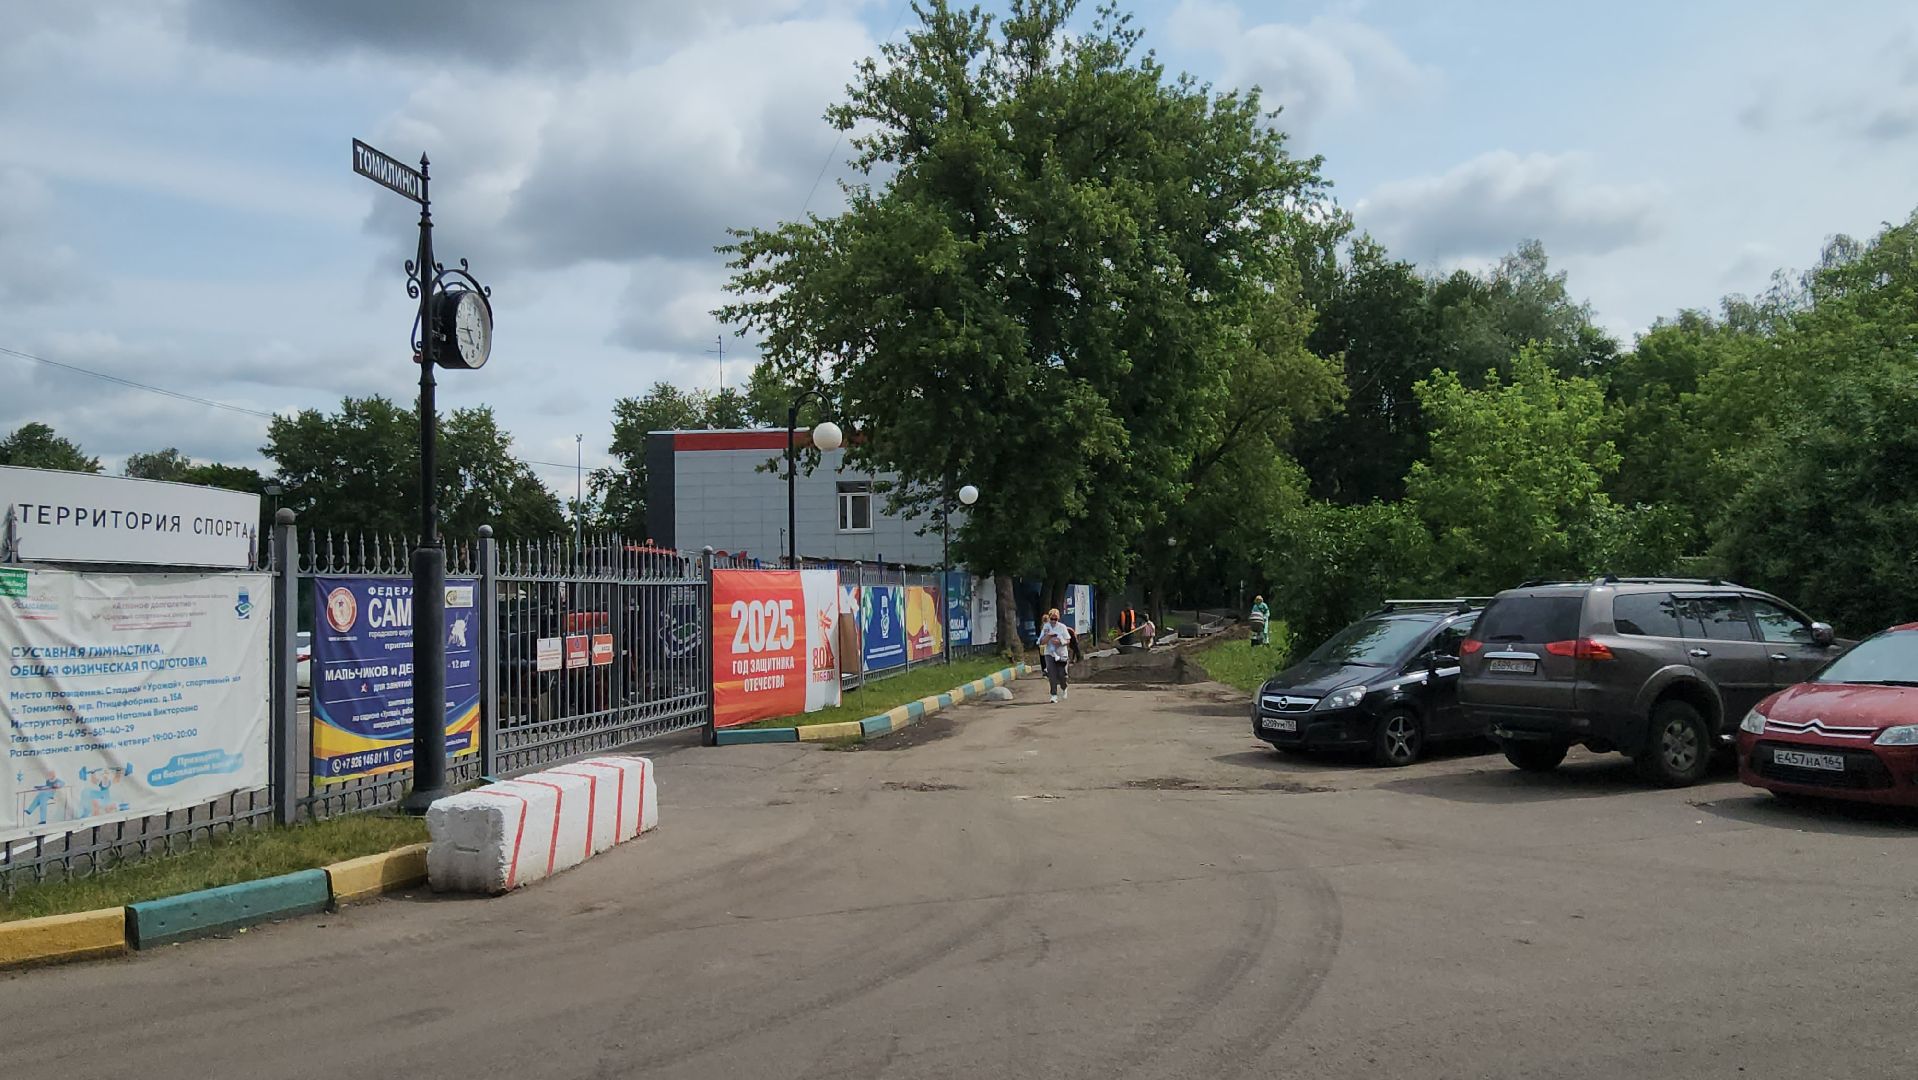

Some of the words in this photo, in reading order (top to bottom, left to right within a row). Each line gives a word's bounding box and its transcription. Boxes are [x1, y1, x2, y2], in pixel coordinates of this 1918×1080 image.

[356, 145, 416, 196] ТОМИЛИНО
[19, 504, 181, 532] ТЕРРИТОРИЯ
[193, 517, 249, 538] СПОРТА
[368, 597, 413, 628] САМ
[731, 599, 794, 654] 2025
[89, 644, 164, 657] ГИМНАСТИКА,
[813, 647, 826, 668] 80
[62, 661, 138, 674] ФИЗИЧЕСКАЯ
[141, 656, 207, 671] ПОДГОТОВКА
[325, 665, 388, 681] МАЛЬЧИКОВ
[391, 667, 397, 675] и
[398, 663, 414, 677] ДЕ
[732, 660, 748, 676] ГОД
[750, 656, 795, 673] ЗАЩИТНИКА
[744, 675, 785, 692] ОТЕЧЕСТВА
[10, 691, 42, 700] Место
[153, 704, 199, 716] Викторовна
[10, 734, 55, 743] Телефон:
[152, 728, 198, 741] 19:00-20:00
[342, 758, 350, 769] +7
